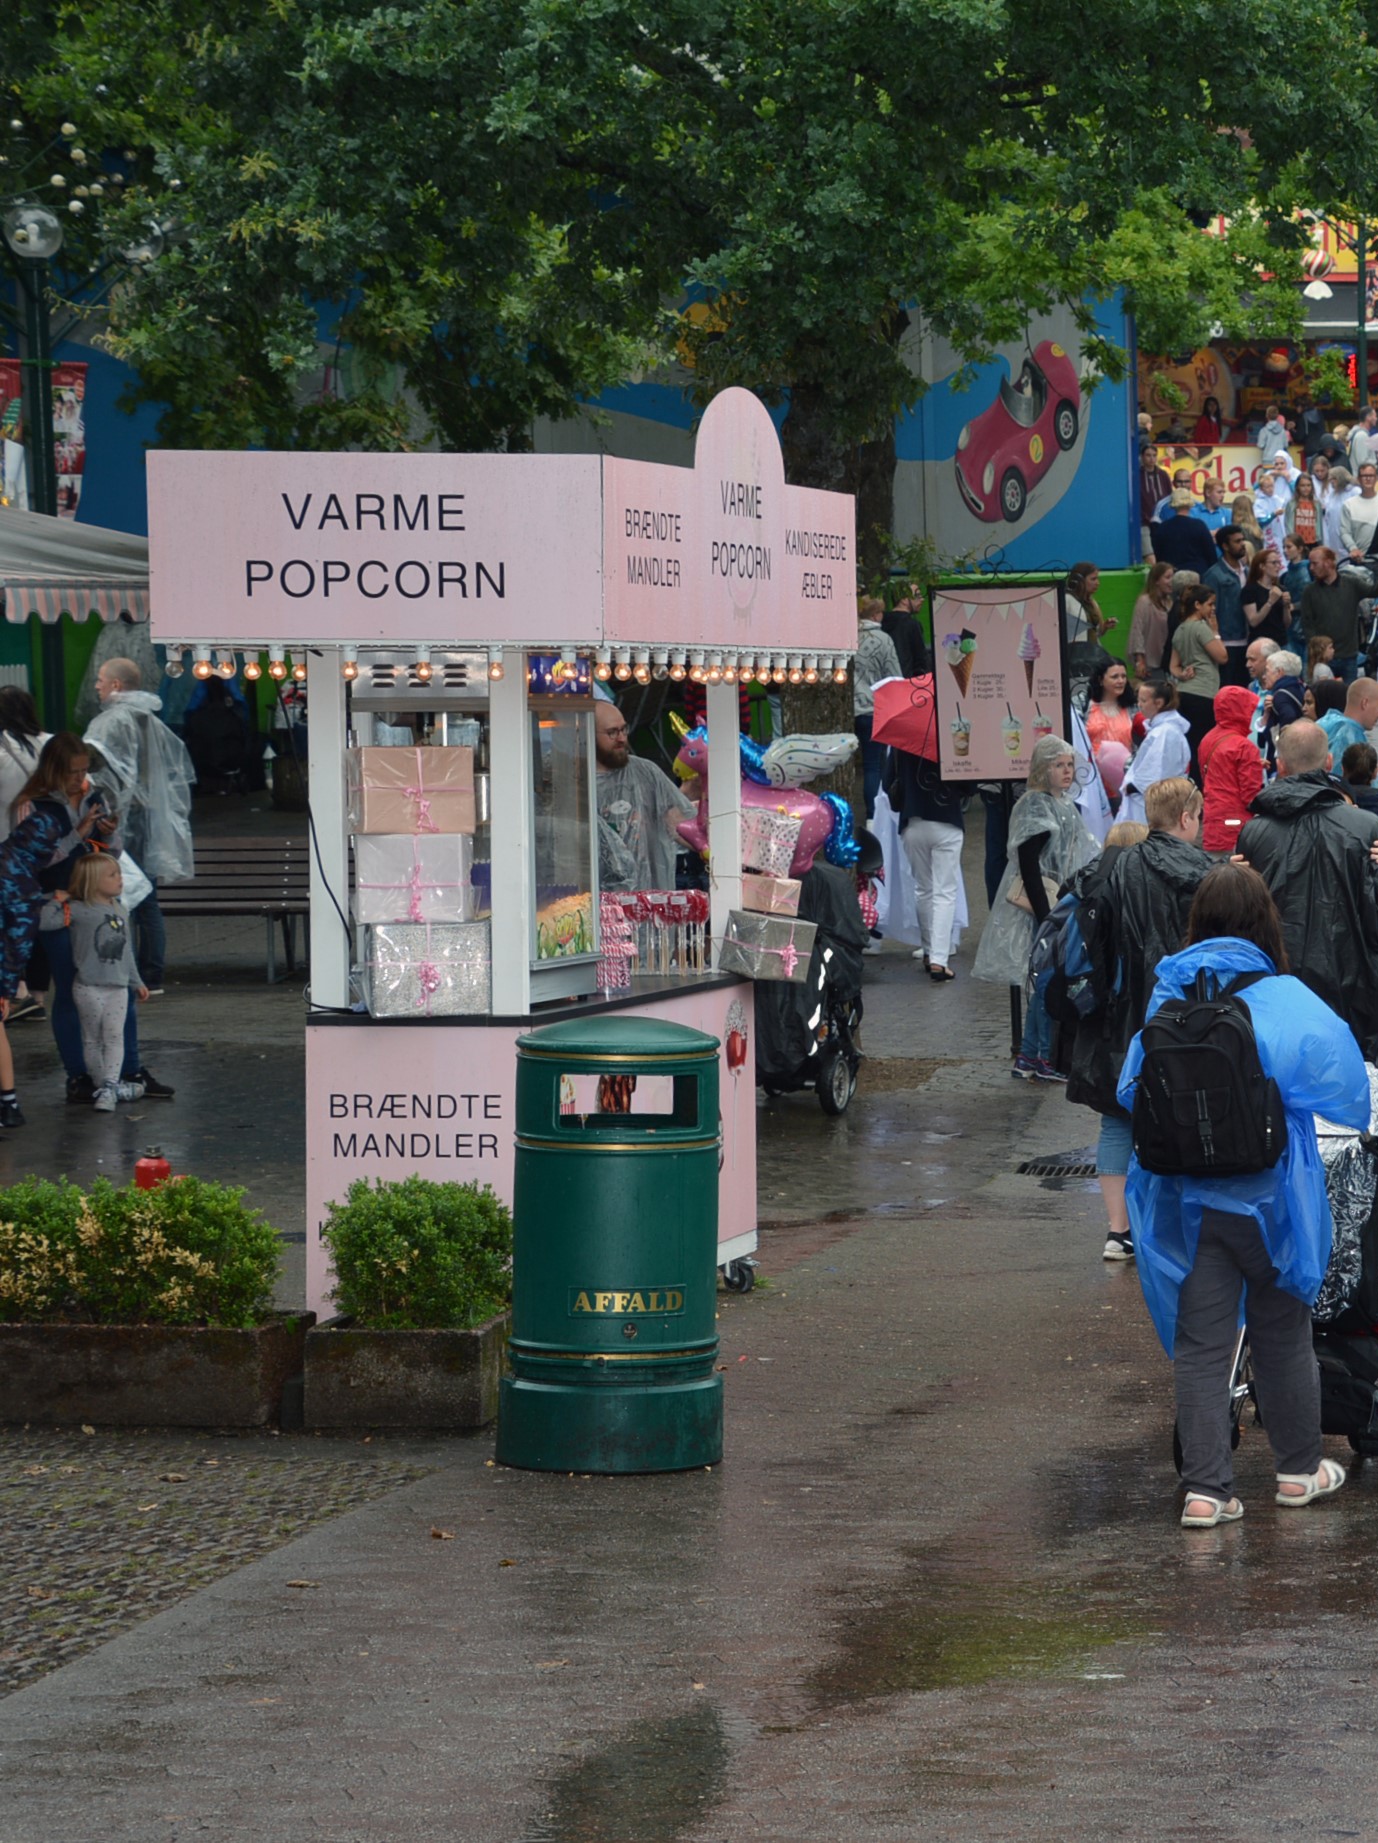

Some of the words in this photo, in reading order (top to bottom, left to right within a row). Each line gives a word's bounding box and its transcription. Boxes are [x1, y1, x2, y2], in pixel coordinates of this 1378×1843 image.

[281, 492, 466, 531] VARME
[720, 480, 762, 519] VARME
[625, 508, 681, 542] BRÆNDTE
[711, 541, 772, 580] POPCORN
[785, 529, 847, 561] KANDISEREDE
[245, 559, 505, 599] POPCORN
[627, 555, 681, 587] MANDLER
[801, 572, 833, 600] ÆBLER
[329, 1093, 502, 1119] BRÆNDTE
[333, 1132, 499, 1158] MANDLER
[572, 1291, 683, 1313] AFFALD
